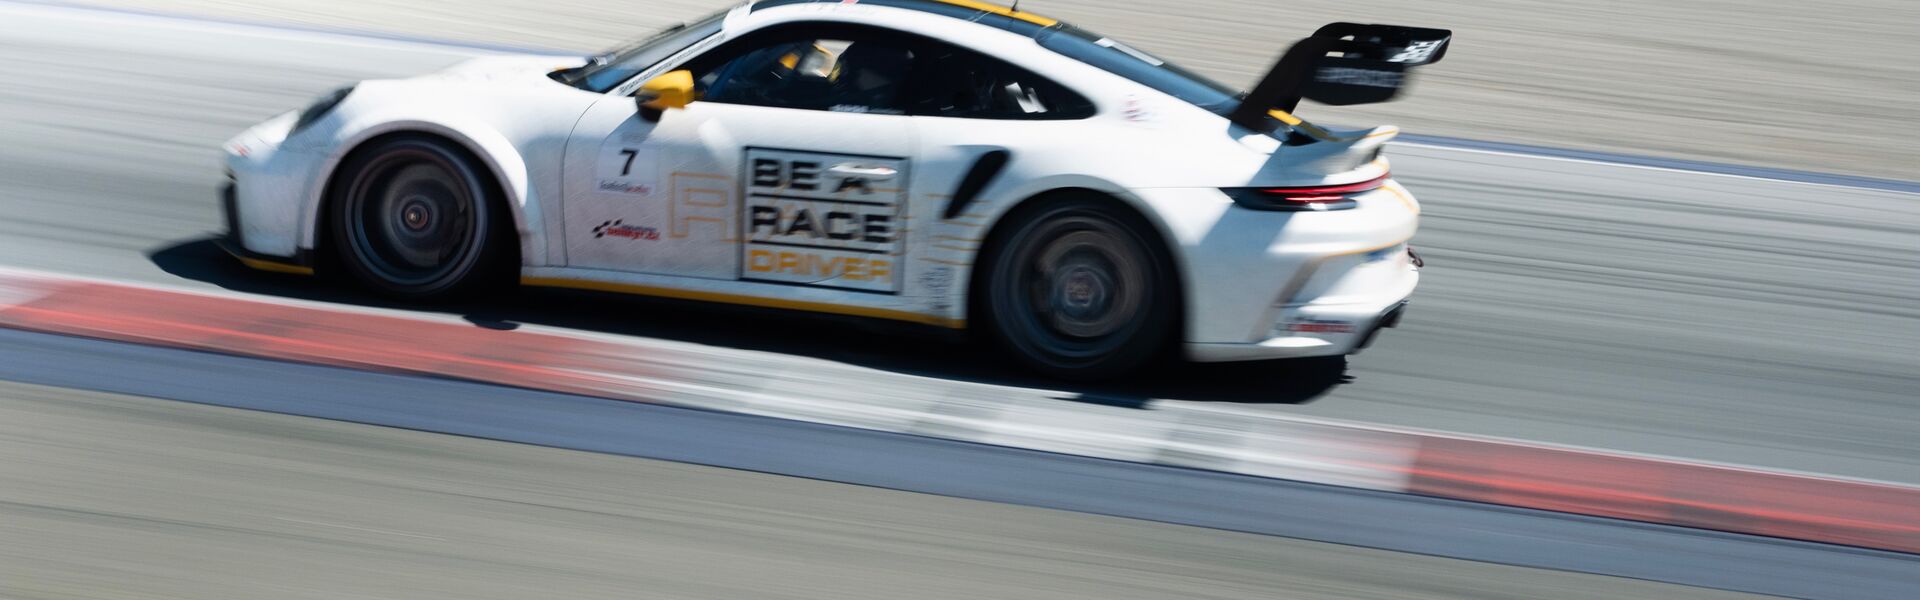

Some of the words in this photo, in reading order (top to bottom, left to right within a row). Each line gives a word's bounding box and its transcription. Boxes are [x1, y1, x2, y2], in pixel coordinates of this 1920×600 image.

[620, 148, 639, 176] 7
[751, 158, 823, 191] BE
[749, 205, 897, 243] RACE
[750, 250, 892, 282] DRIVER
